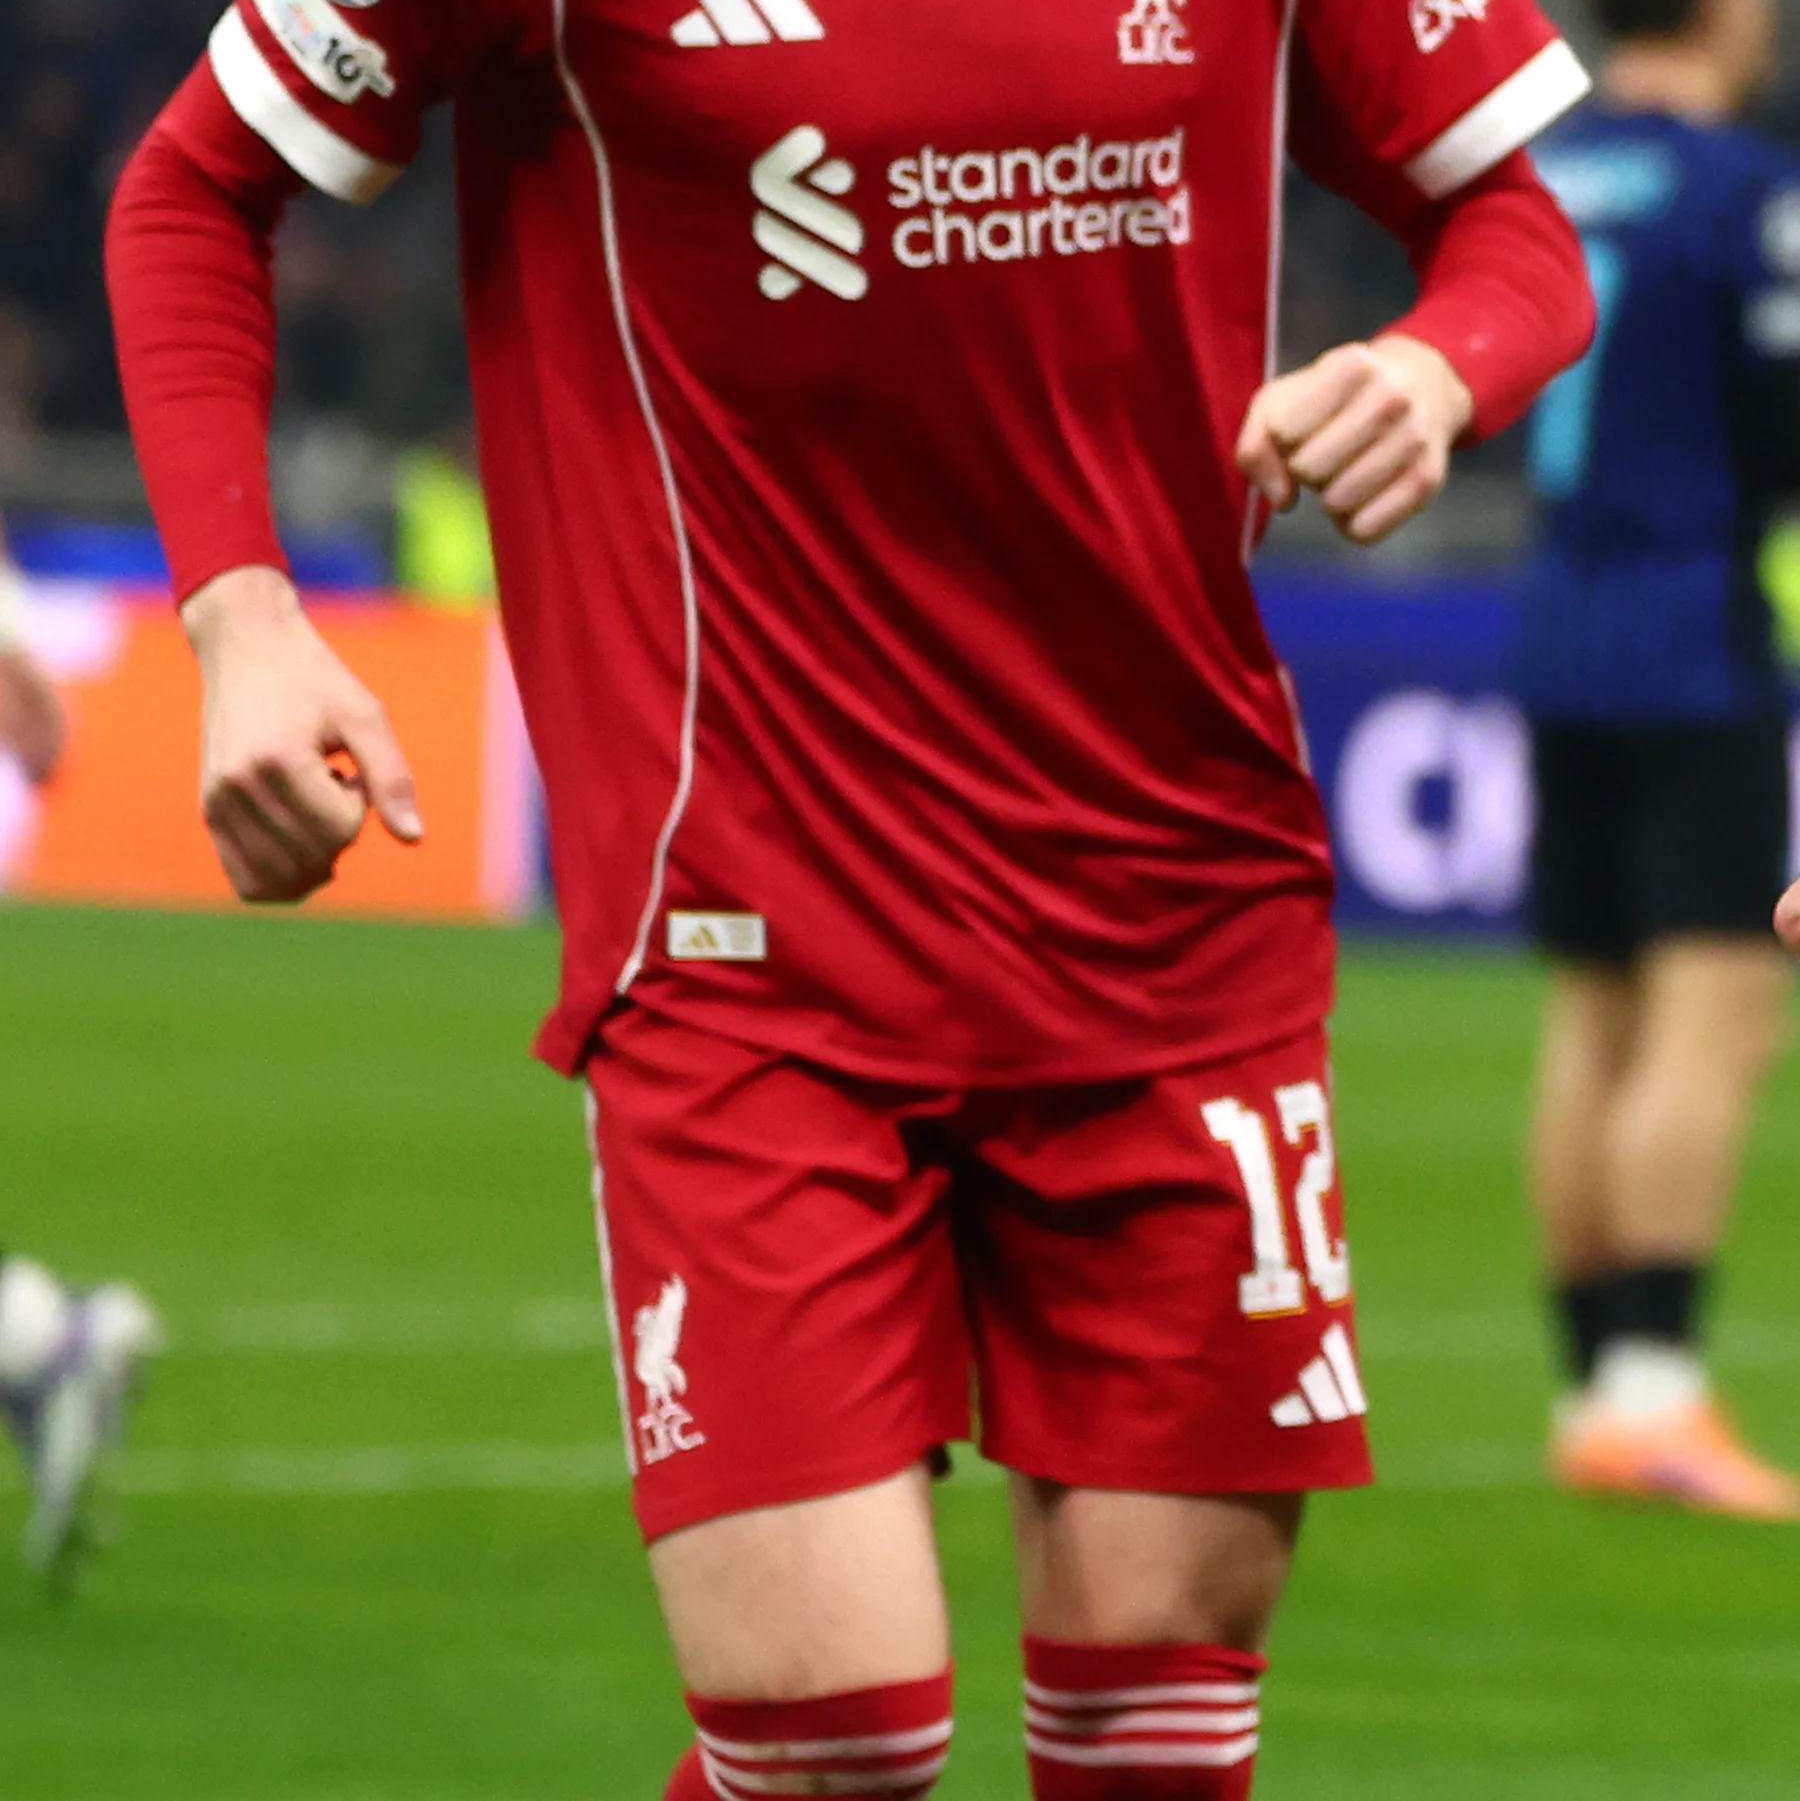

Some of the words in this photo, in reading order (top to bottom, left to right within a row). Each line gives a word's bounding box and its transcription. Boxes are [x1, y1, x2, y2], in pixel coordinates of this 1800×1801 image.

[888, 125, 1185, 209] standard
[891, 185, 1192, 269] chartered
[1202, 1080, 1353, 1319] 12
